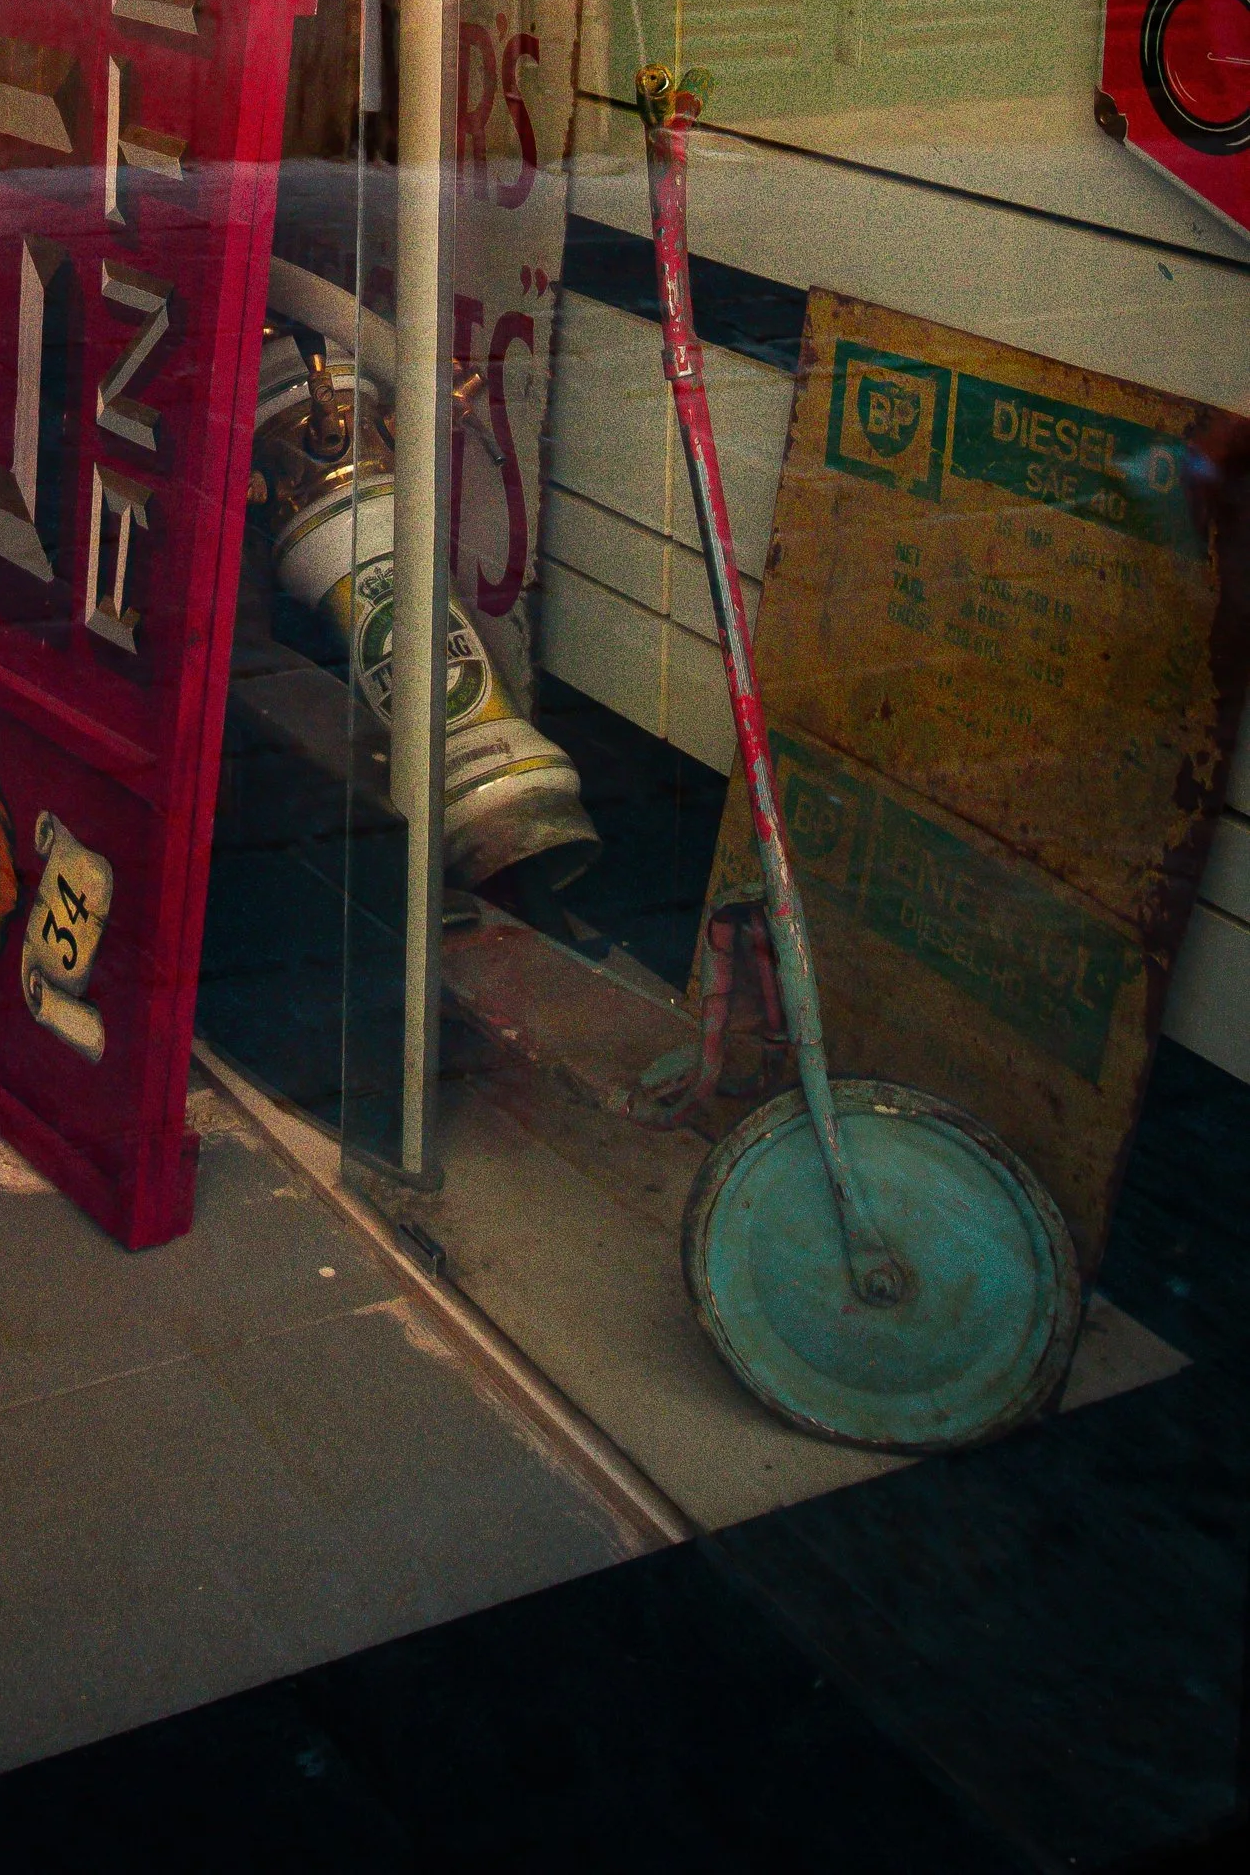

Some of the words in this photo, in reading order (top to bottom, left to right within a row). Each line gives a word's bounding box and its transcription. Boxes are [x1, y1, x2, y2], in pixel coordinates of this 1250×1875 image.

[867, 389, 917, 441] BP
[992, 398, 1128, 478] DIESEL
[1025, 461, 1080, 502] SAE
[40, 873, 88, 971] 34
